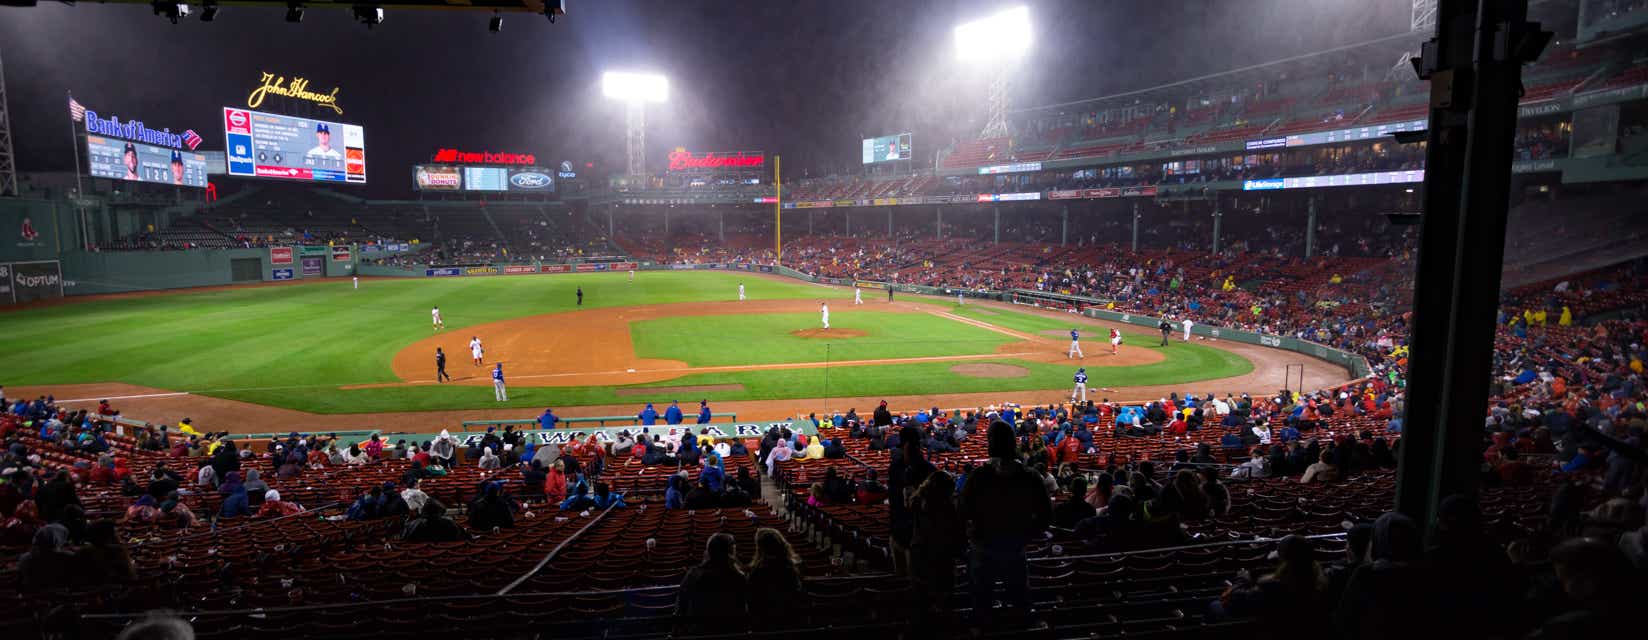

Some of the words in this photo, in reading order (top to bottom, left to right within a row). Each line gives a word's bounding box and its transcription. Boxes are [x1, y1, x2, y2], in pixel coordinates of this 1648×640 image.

[248, 72, 288, 108] John
[286, 77, 343, 115] Hancock
[85, 110, 123, 138] Bank
[124, 119, 136, 140] of
[138, 121, 182, 149] America
[458, 152, 483, 163] new
[485, 151, 535, 165] balance
[668, 151, 764, 170] Budweiser
[519, 174, 543, 185] Ford
[27, 274, 58, 287] OPTUM
